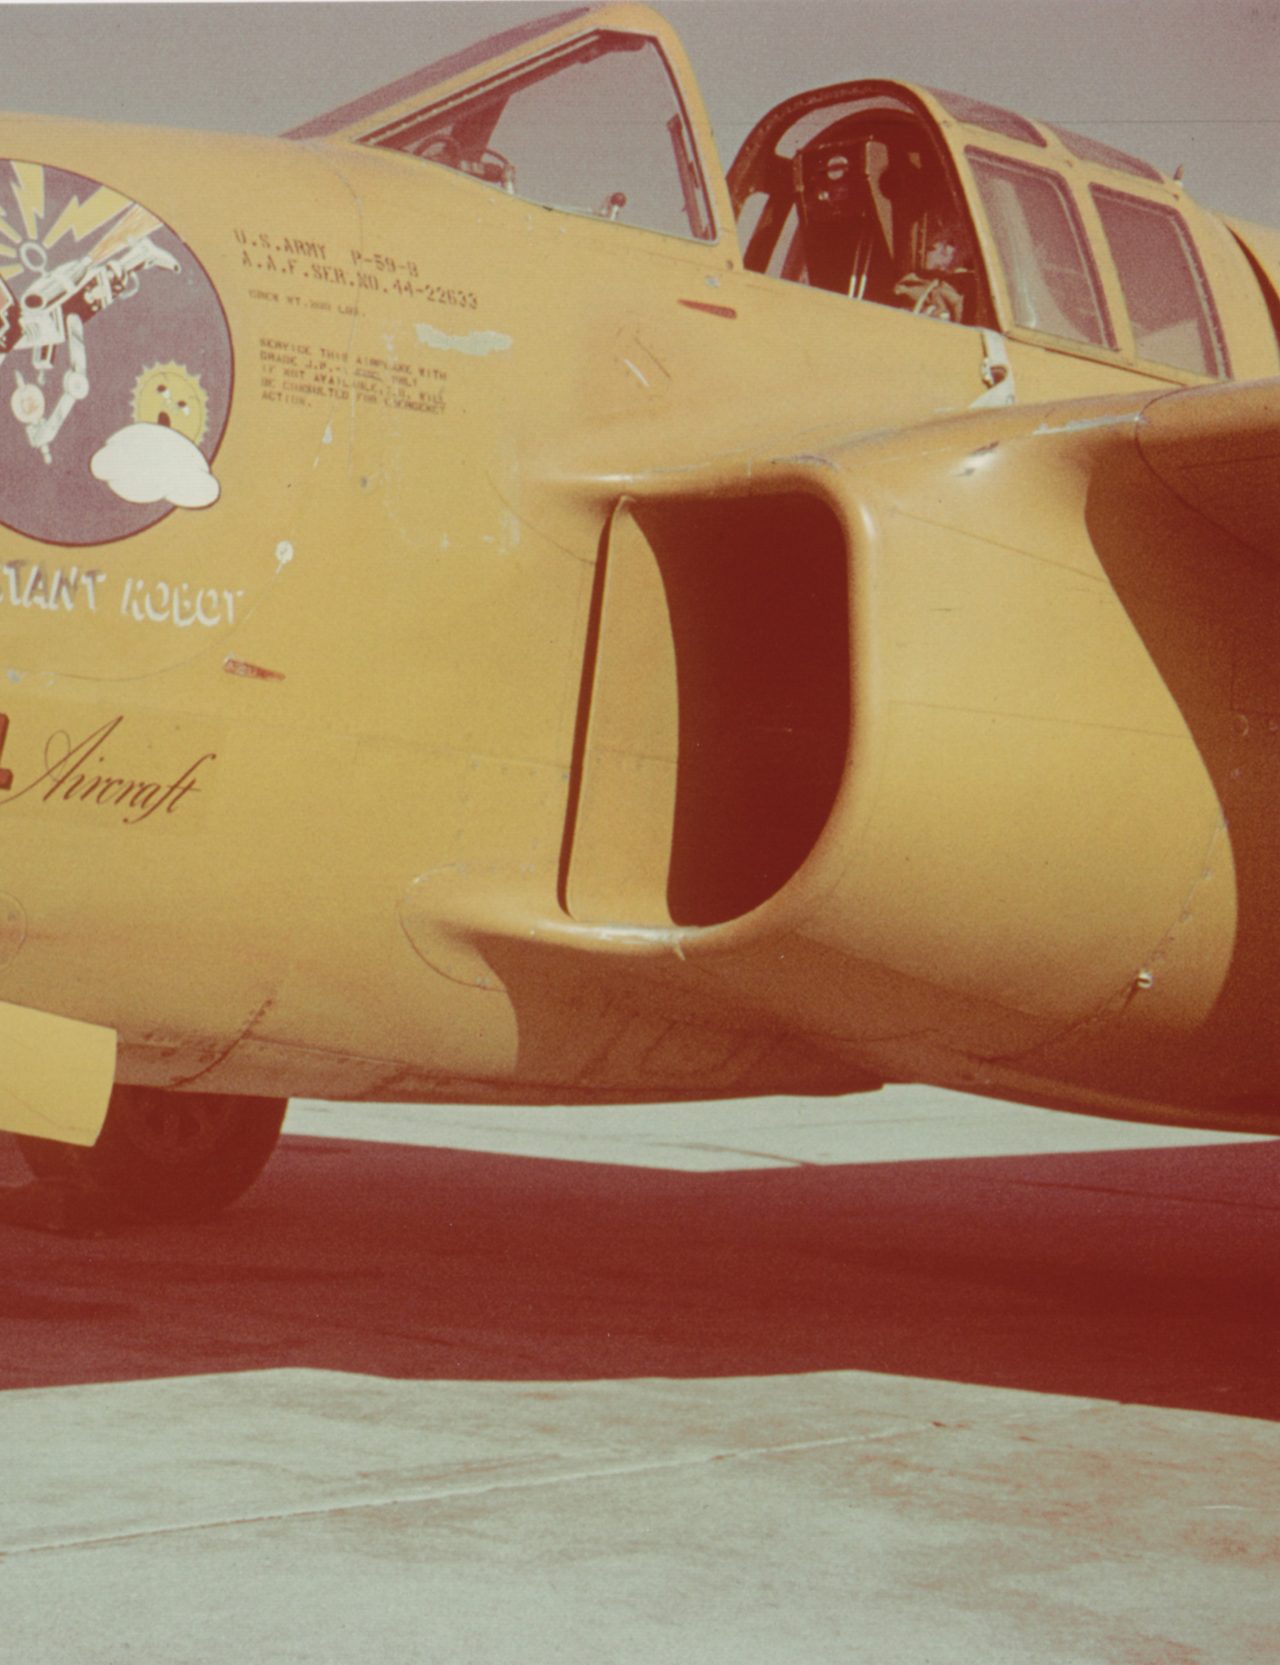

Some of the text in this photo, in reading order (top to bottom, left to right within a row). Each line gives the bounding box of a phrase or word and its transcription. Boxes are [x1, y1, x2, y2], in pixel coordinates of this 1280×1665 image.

[259, 350, 297, 367] GRADE
[259, 338, 312, 356] SERVICE
[320, 347, 348, 363] THIS
[418, 367, 447, 381] WITH
[262, 364, 276, 374] IF
[283, 368, 305, 380] NOT
[121, 577, 246, 627] ROBOT
